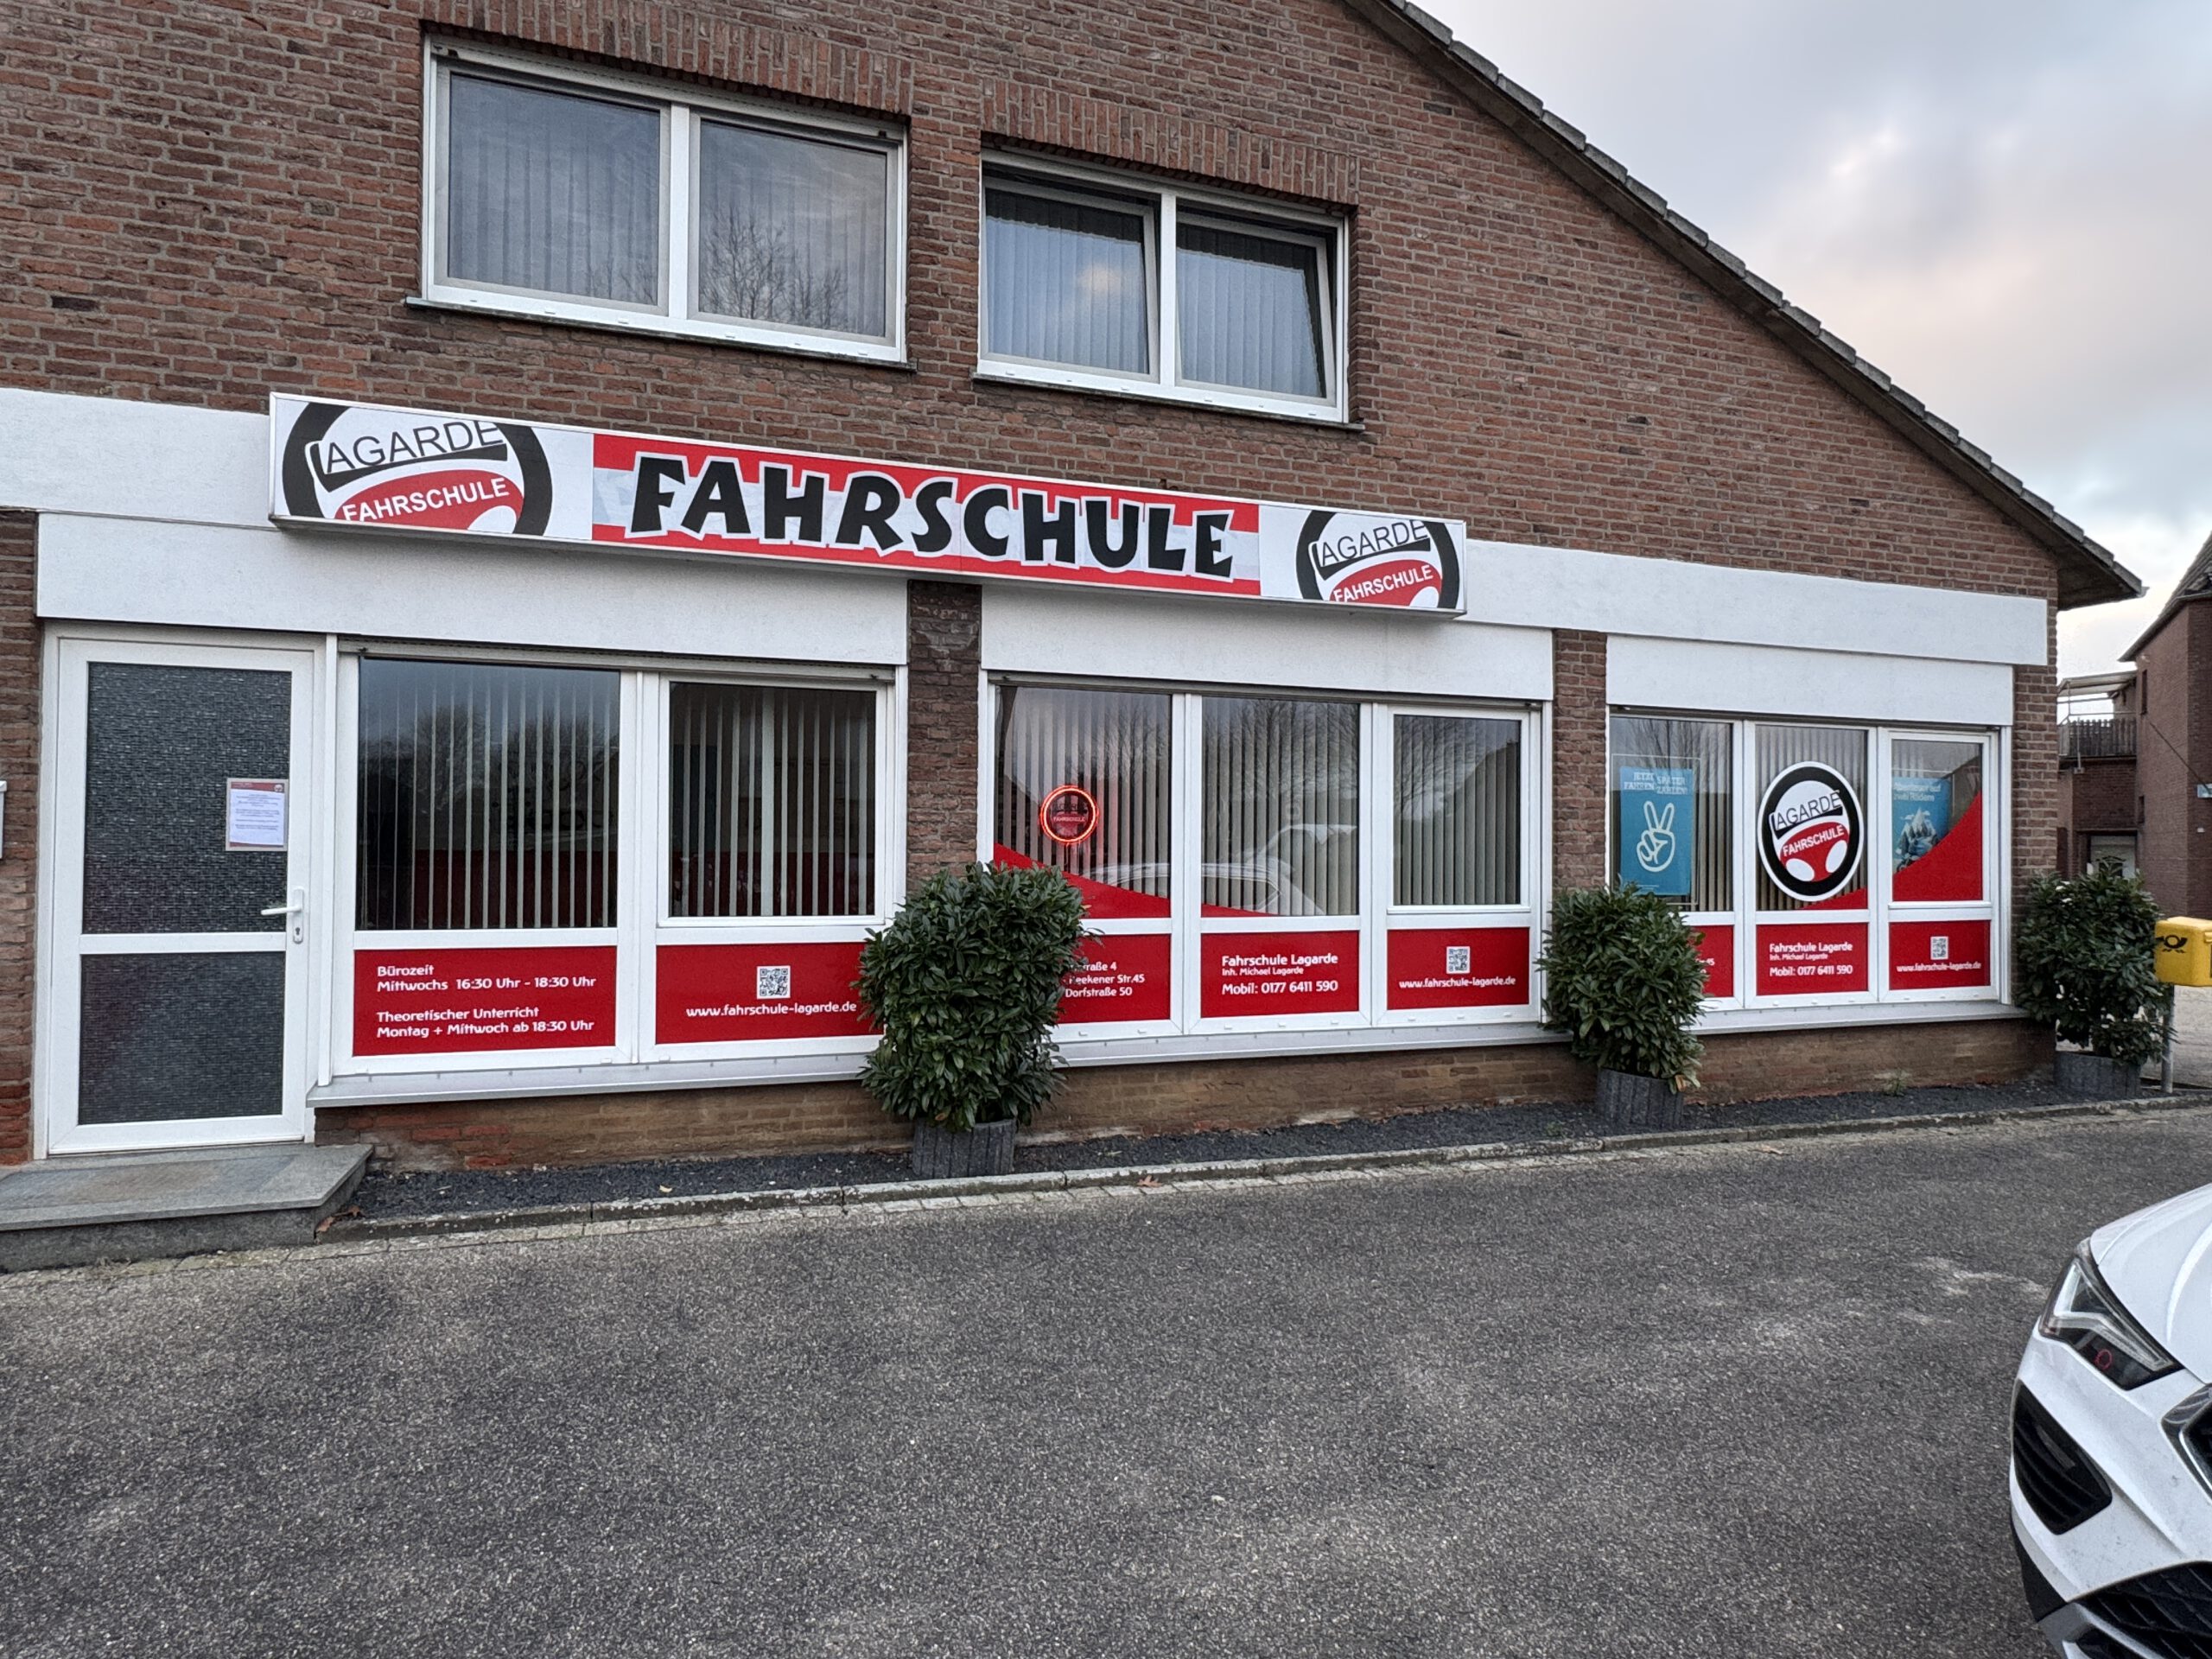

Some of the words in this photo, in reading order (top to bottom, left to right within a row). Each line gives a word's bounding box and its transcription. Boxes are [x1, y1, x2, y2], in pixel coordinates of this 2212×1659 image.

[342, 478, 509, 522] FAHRSCHULE
[630, 455, 1233, 578] FAHRSCHULE
[1332, 564, 1433, 602] FAHRSCHULE
[1782, 824, 1845, 857] FAHRSCHULE
[1769, 942, 1817, 953] Fahrschule
[1818, 941, 1853, 954] Lagarde
[1109, 961, 1117, 971] 4
[1222, 954, 1288, 967] Fahrschule
[1291, 953, 1338, 967] Lagarde
[1896, 961, 1982, 972] www.fahrschule-lagarde.de
[377, 964, 434, 977] Bürozeit
[1222, 968, 1238, 976] Inh.
[1239, 967, 1271, 976] Michael
[1273, 967, 1305, 976] Lagarde
[1769, 966, 1796, 976] Mobil:
[1797, 965, 1816, 976] 0177
[1817, 965, 1834, 976] 6411
[1836, 964, 1853, 975] 590
[377, 979, 448, 992] Mittwochs
[455, 978, 493, 989] 16:30
[496, 977, 521, 988] Uhr
[534, 977, 569, 988] 18:30
[572, 976, 596, 987] Uhr
[1222, 982, 1259, 995] Mobil:
[1262, 982, 1287, 994] 0177
[1289, 981, 1313, 993] 6411
[1316, 980, 1338, 992] 590
[1398, 976, 1516, 989] www.fahrschule-lagarde.de
[1065, 987, 1117, 998] Dorfstraße
[1119, 987, 1133, 996] 50
[376, 1008, 469, 1022] Theoretischer
[474, 1007, 539, 1020] Unterricht
[685, 1001, 857, 1018] www.fahrschule-lagarde.de
[377, 1026, 429, 1039] Montag
[447, 1021, 509, 1035] Mittwoch
[512, 1021, 529, 1033] ab
[532, 1020, 567, 1033] 18:30
[570, 1020, 594, 1031] Uhr
